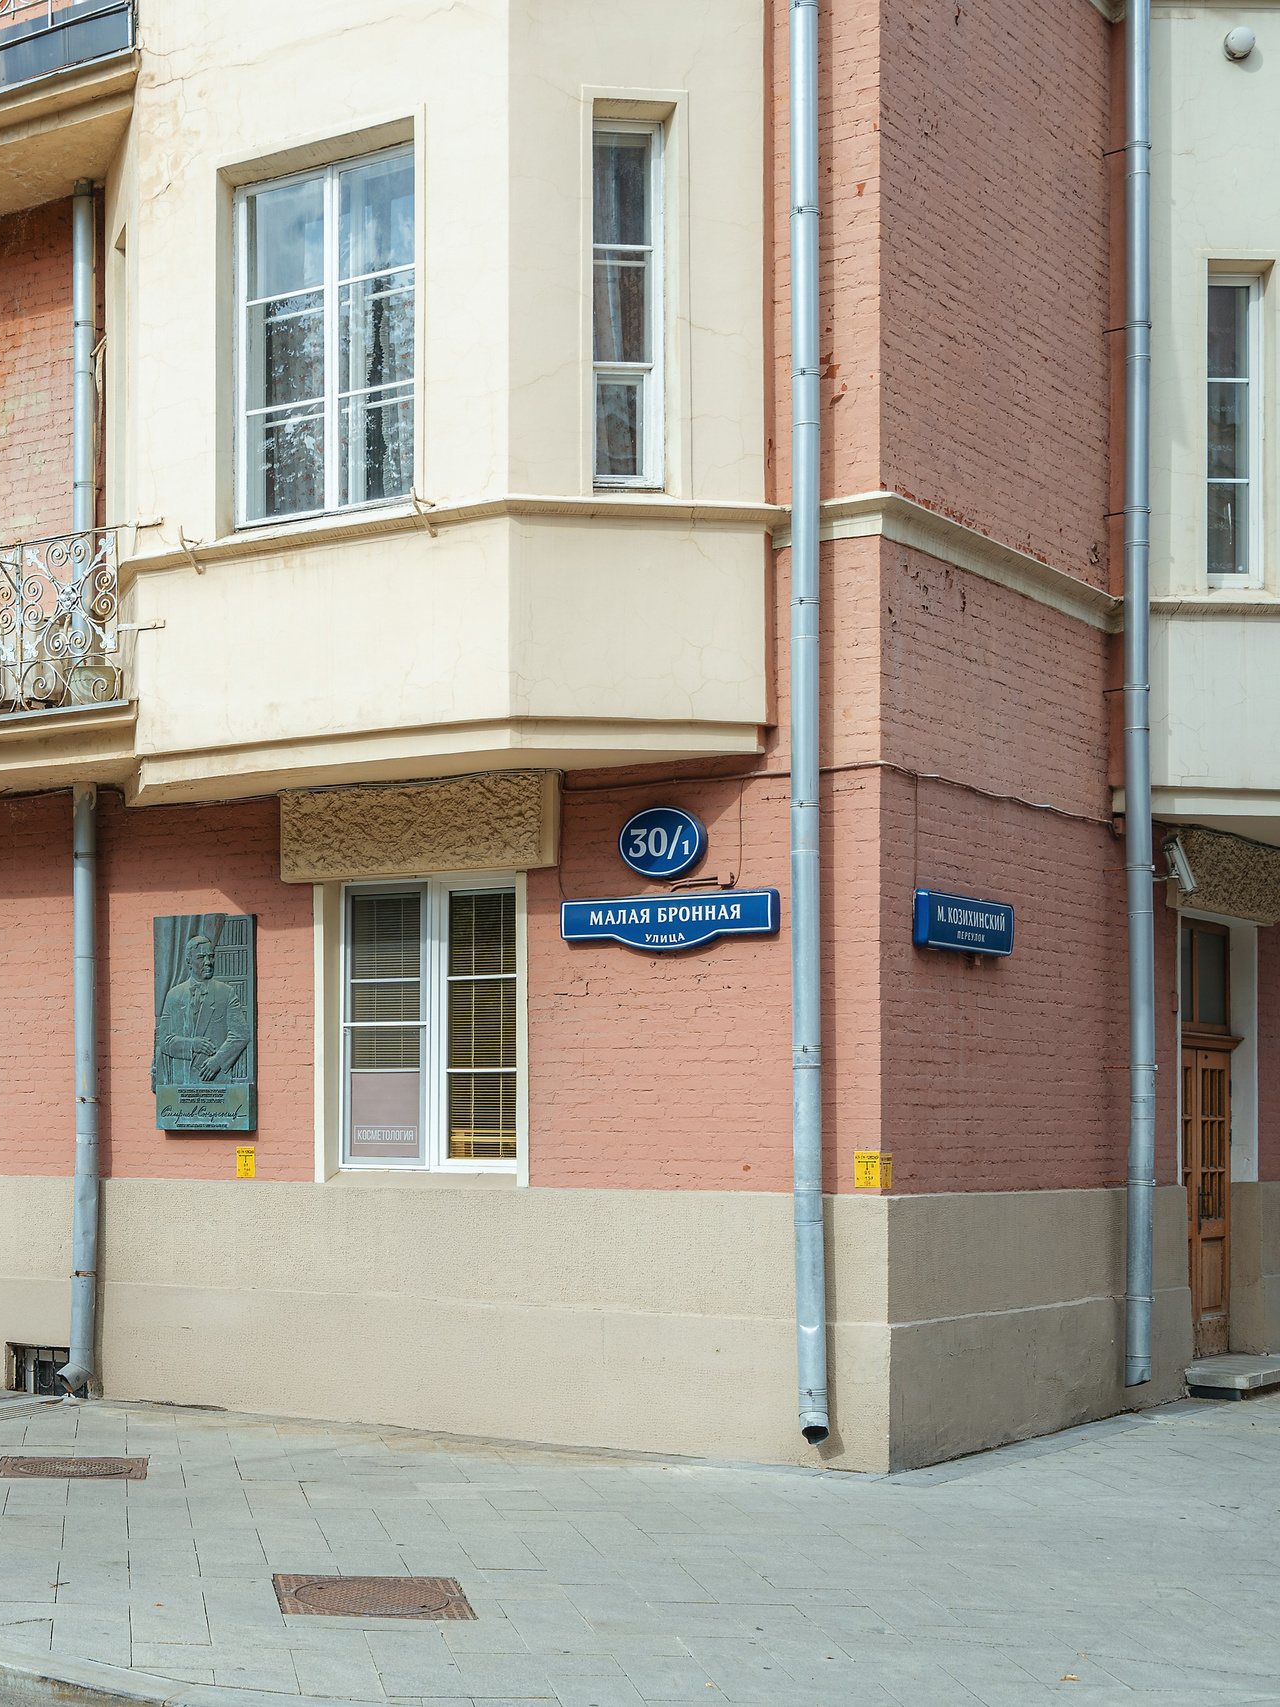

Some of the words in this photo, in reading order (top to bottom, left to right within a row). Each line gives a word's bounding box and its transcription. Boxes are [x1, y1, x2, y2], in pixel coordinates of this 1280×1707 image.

[628, 825, 690, 860] 30/1
[589, 908, 651, 926] МАЛАЯ
[657, 903, 742, 923] БРОННАЯ
[937, 905, 946, 922] М.
[948, 906, 1006, 932] КОЗИХИНСКИЙ
[645, 932, 685, 944] УЛИЦА
[956, 930, 986, 943] ПЕРЕУЛОК
[357, 1129, 414, 1141] КОСМЕТОЛОГИЯ
